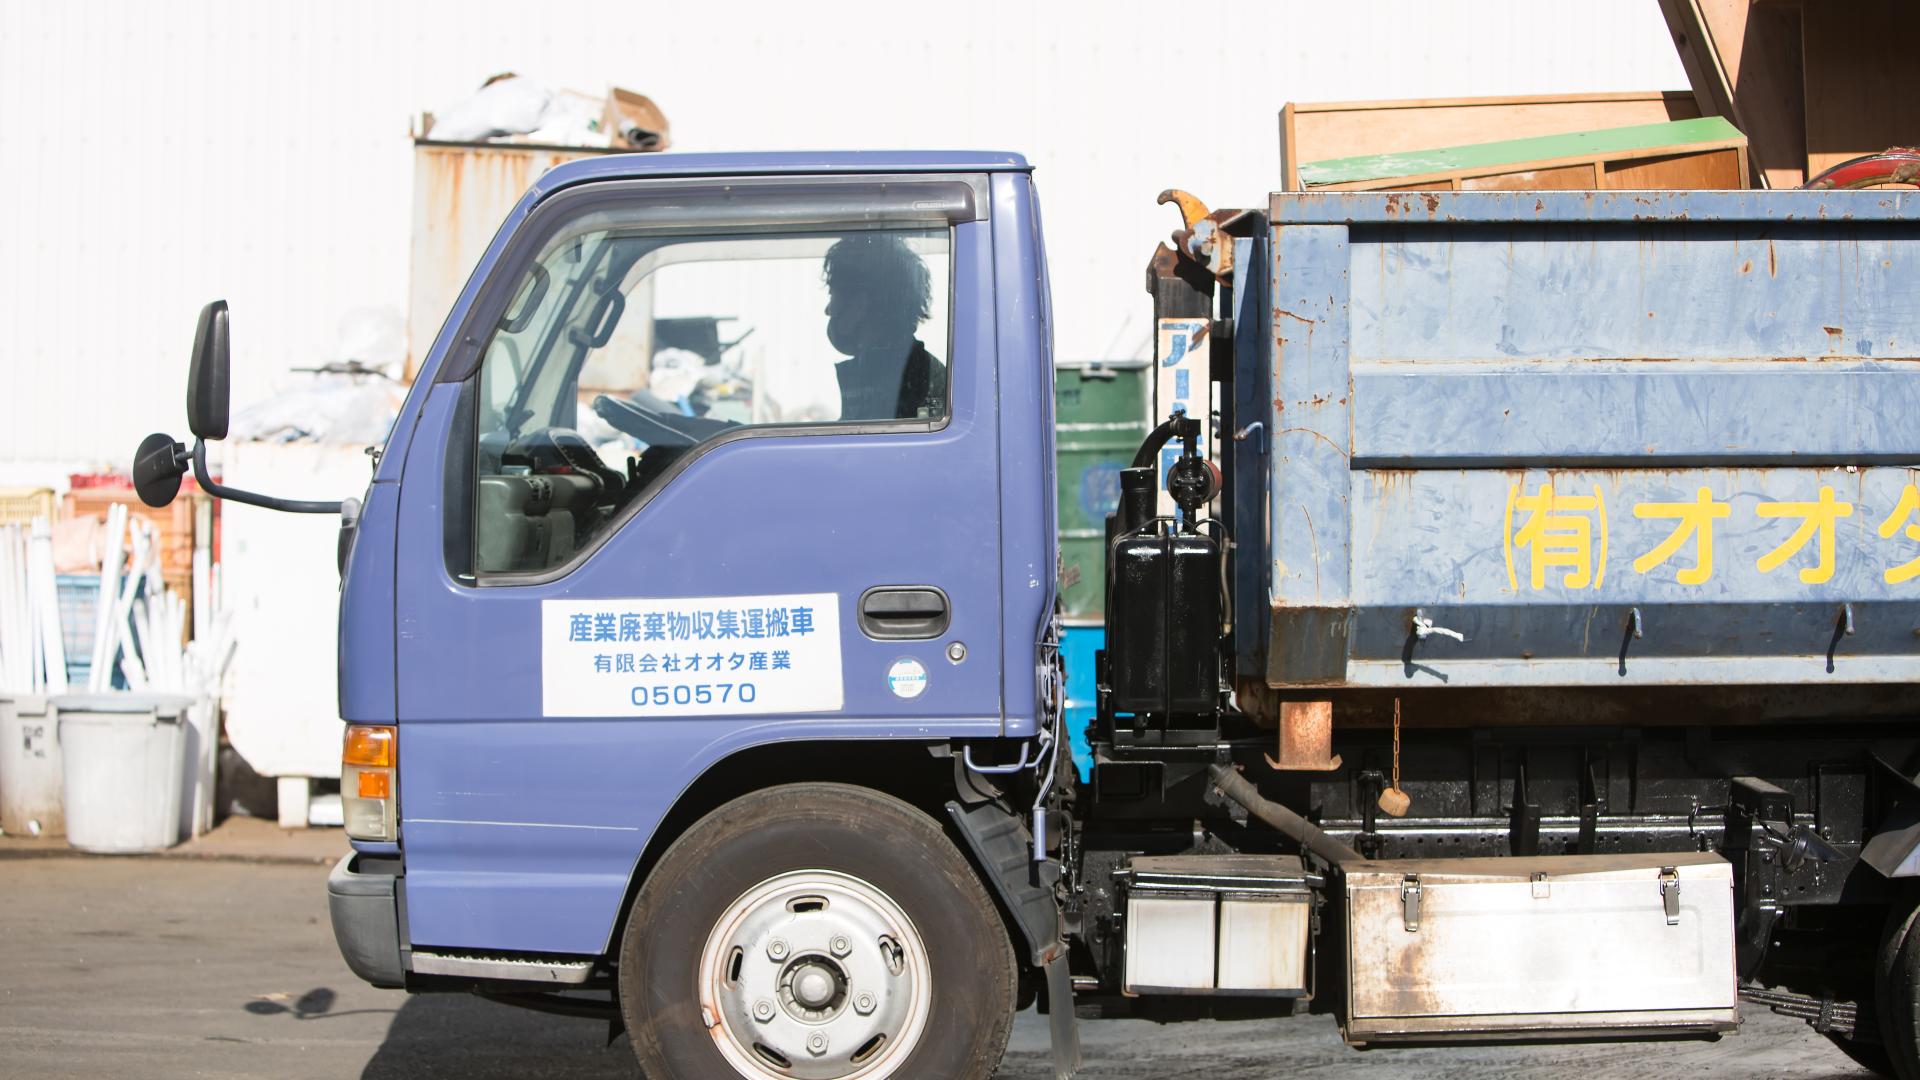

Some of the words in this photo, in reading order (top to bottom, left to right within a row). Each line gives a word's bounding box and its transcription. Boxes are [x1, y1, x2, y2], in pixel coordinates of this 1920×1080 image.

[569, 606, 816, 642] 産業廃棄物収集運搬車
[594, 650, 792, 673] 有限会社オオタ産業
[631, 683, 757, 706] 050570
